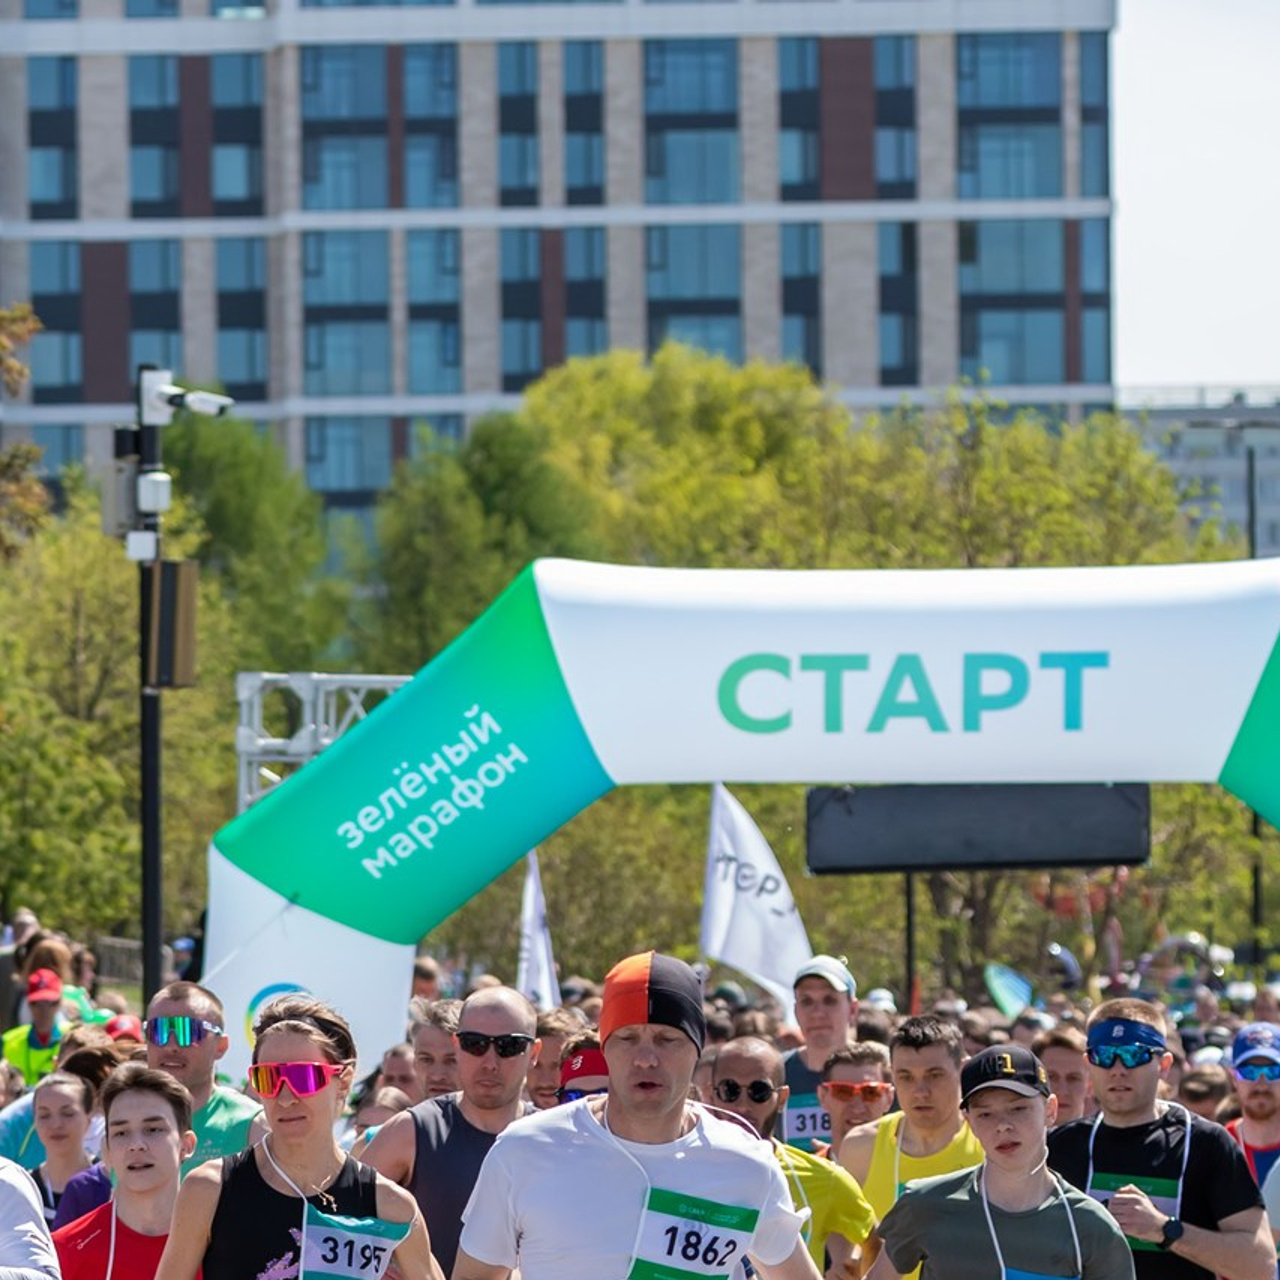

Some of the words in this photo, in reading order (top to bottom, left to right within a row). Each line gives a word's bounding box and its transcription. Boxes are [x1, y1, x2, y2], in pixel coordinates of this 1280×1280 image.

[716, 650, 1111, 735] СТАРТ
[336, 703, 503, 850] зелёный
[360, 742, 529, 880] марафон
[795, 1112, 832, 1132] 318
[321, 1235, 388, 1274] 3195
[664, 1225, 738, 1267] 1862
